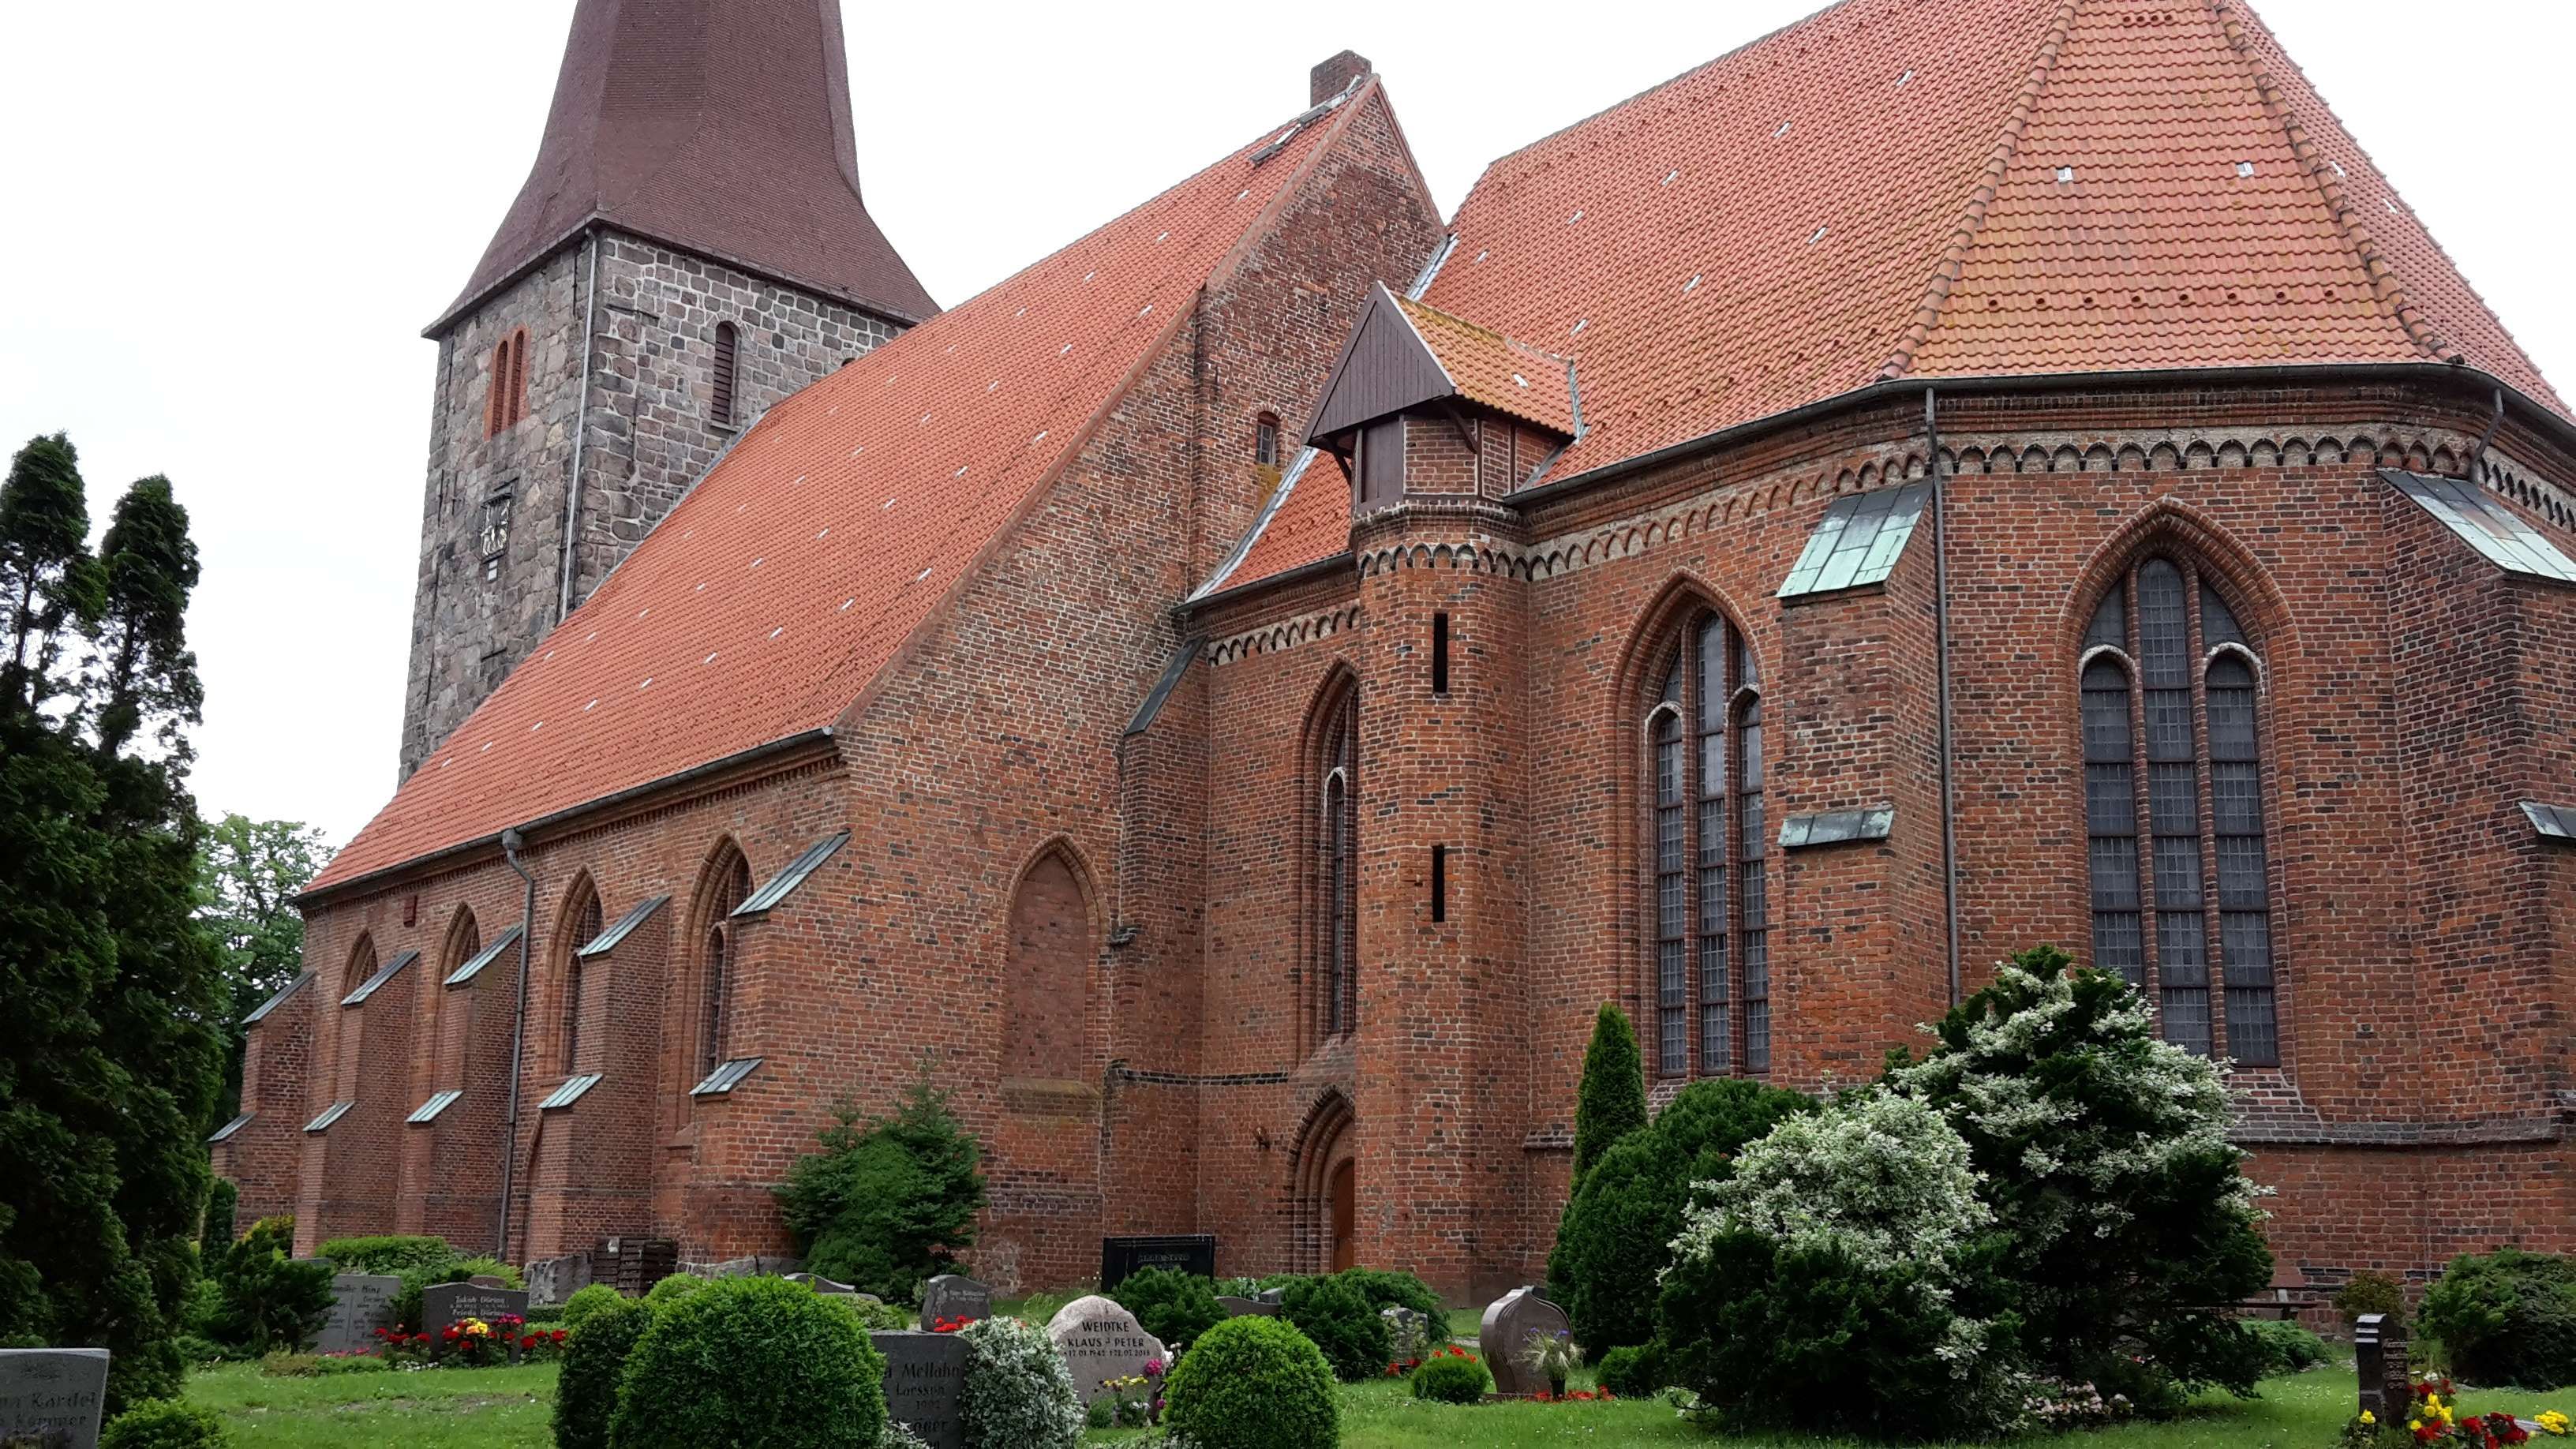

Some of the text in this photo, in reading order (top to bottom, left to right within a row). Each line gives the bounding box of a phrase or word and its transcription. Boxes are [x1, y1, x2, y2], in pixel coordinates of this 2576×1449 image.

[1082, 1321, 1130, 1332] WEIDTKE
[1068, 1338, 1103, 1347] KLAUS
[1114, 1338, 1144, 1347] PETER
[902, 1362, 960, 1378] Mellahn
